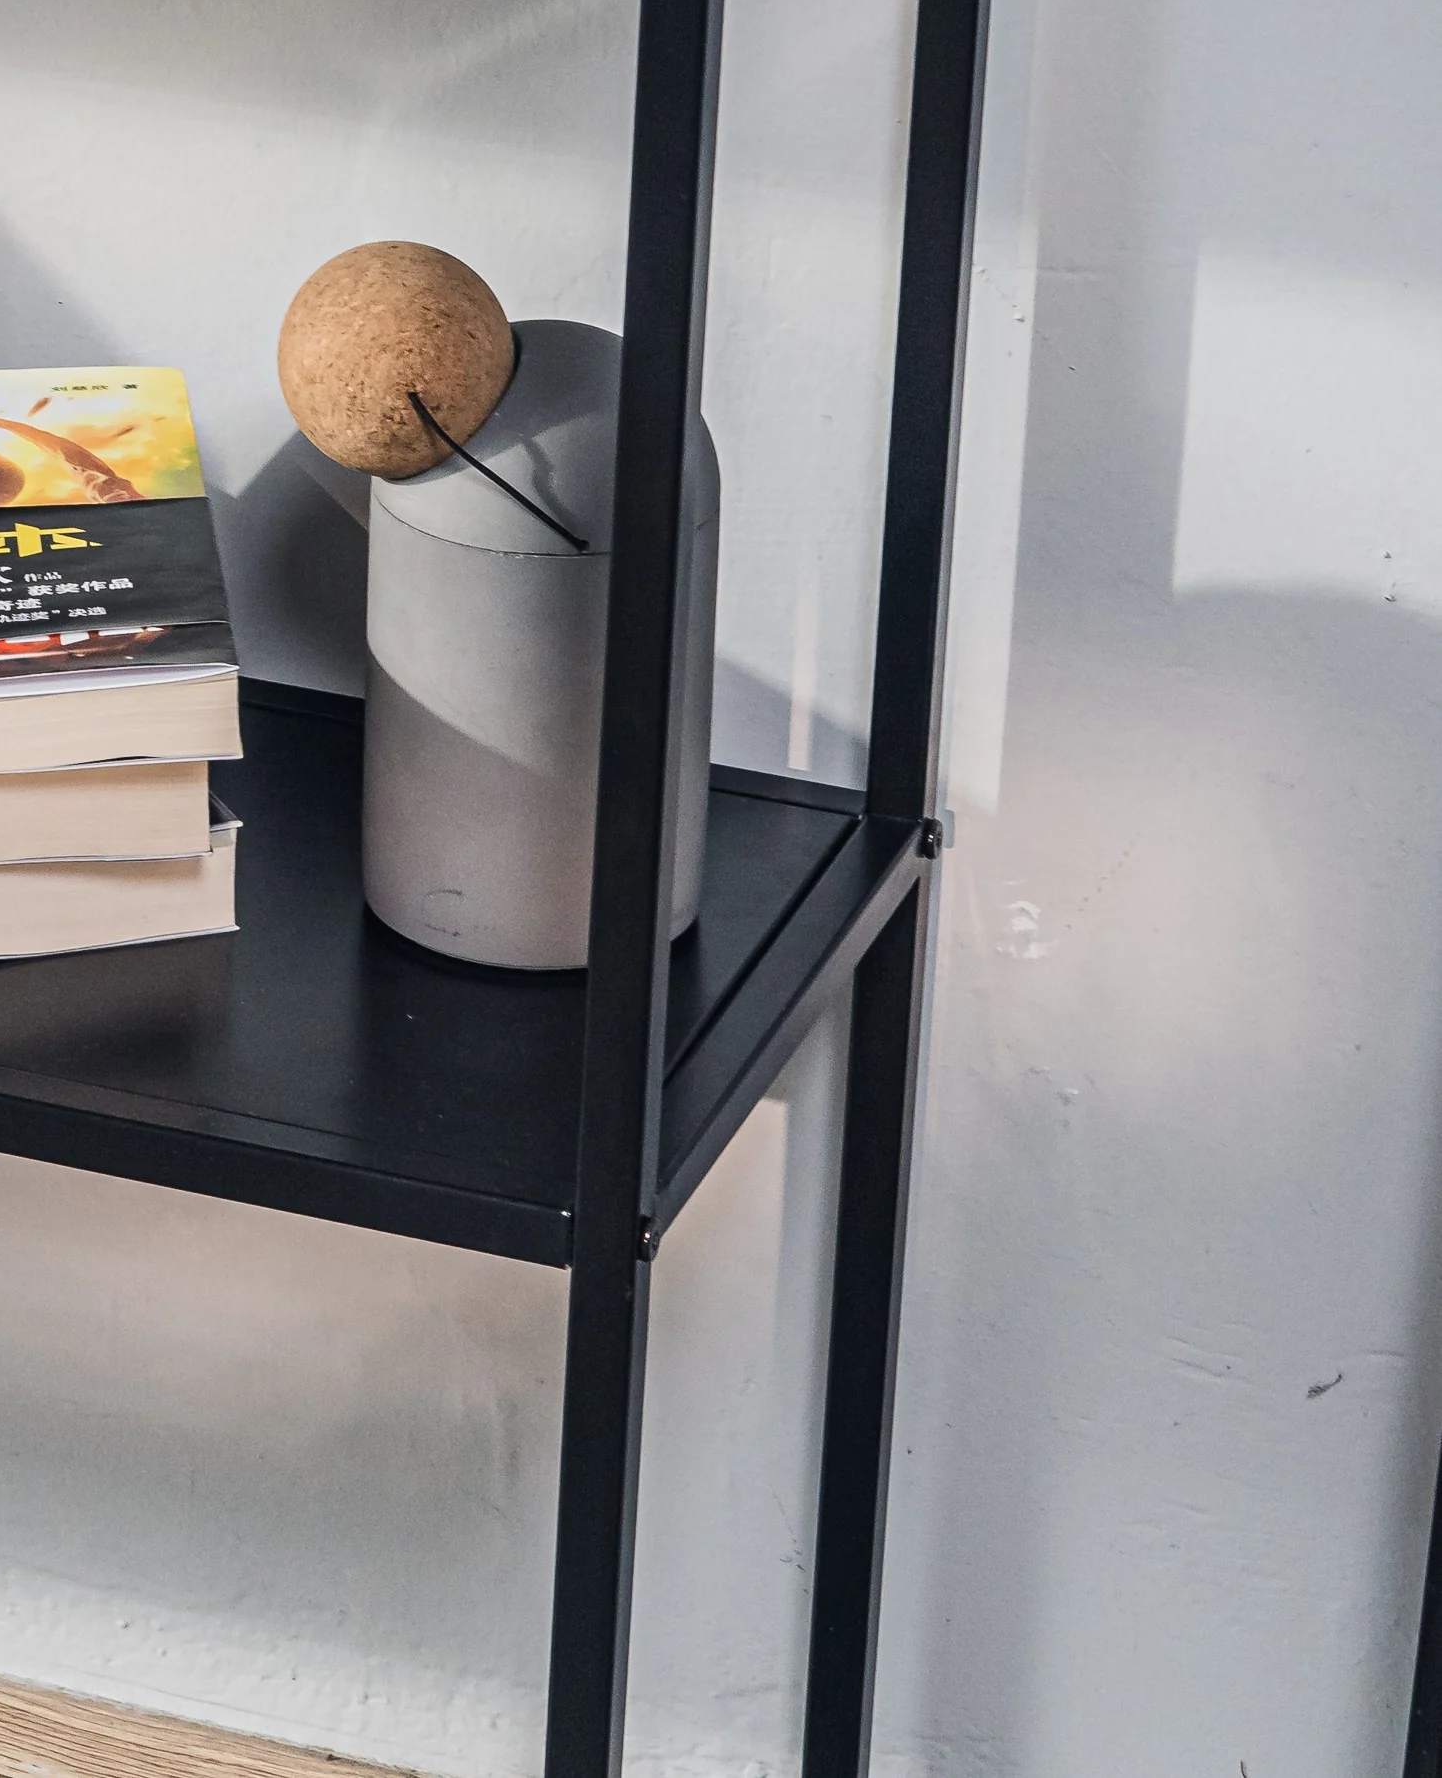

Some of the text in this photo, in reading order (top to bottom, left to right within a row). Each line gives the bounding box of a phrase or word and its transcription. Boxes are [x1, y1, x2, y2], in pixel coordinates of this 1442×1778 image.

[23, 569, 63, 583] 作品
[27, 576, 135, 597] 获奖作品
